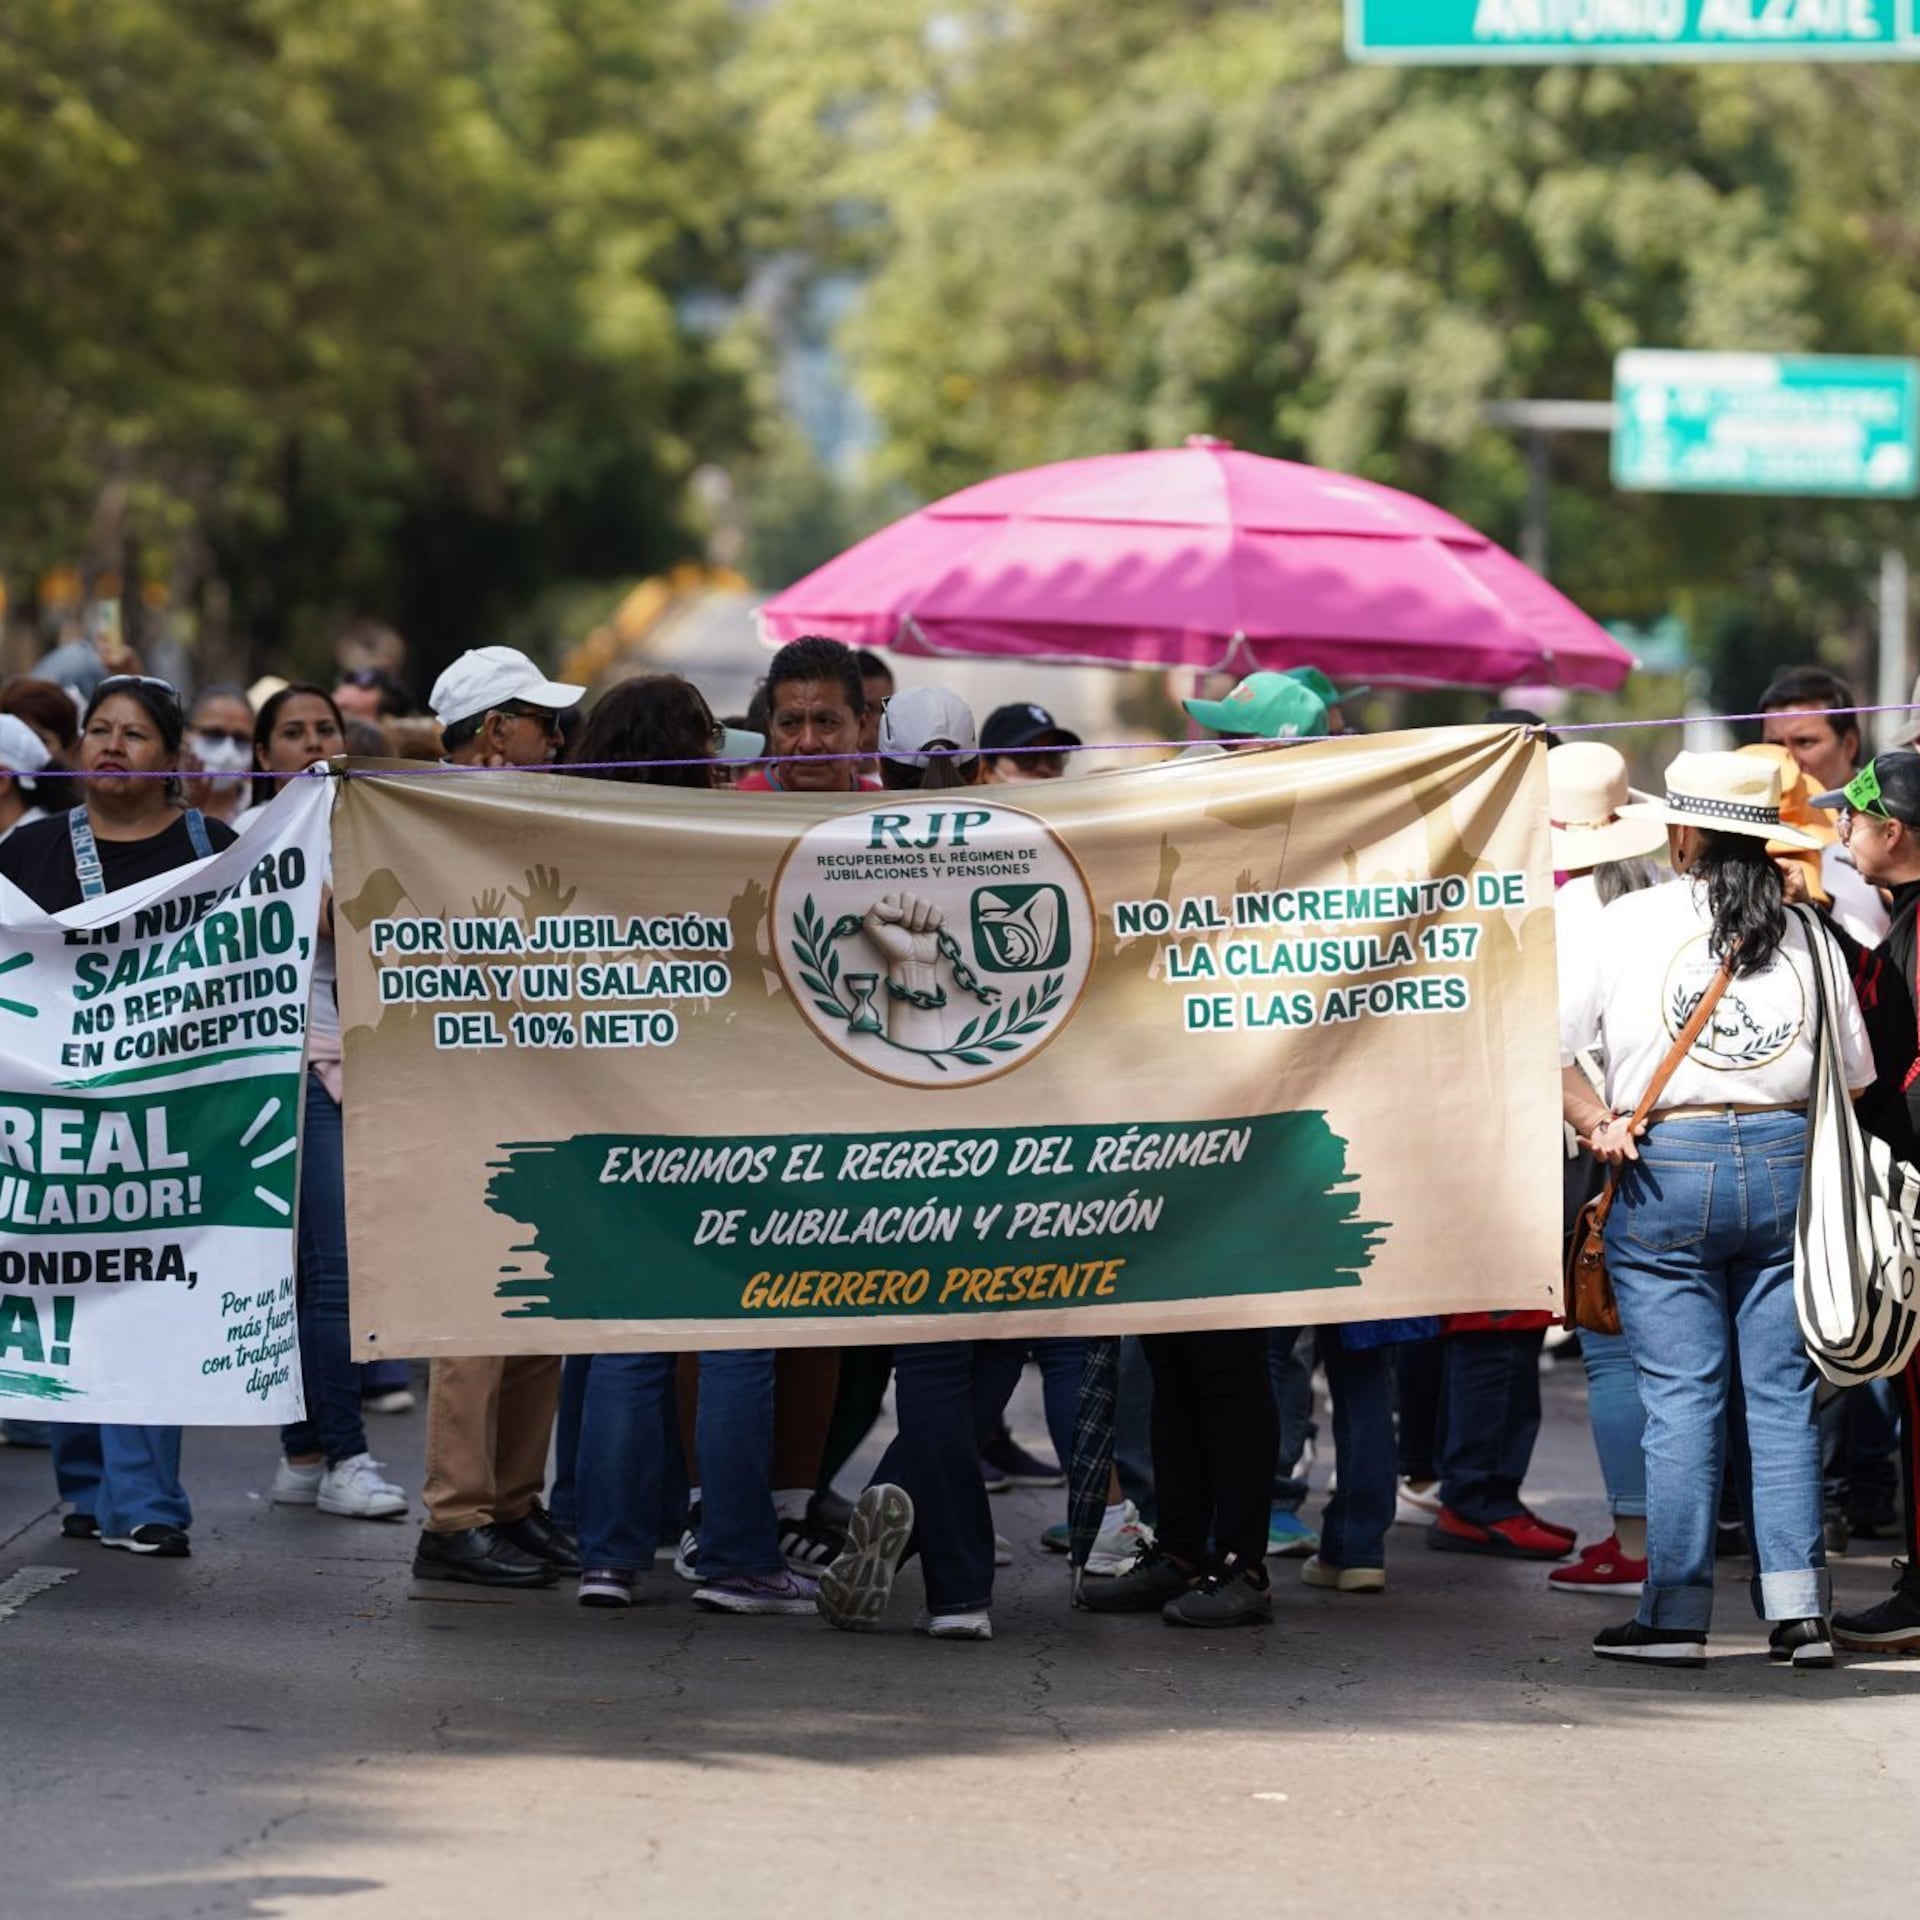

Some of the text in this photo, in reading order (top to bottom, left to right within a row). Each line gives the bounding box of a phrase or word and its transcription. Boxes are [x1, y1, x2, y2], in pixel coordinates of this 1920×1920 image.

[866, 811, 992, 850] RJP
[817, 848, 1038, 867] RECUPEREMOS EL RÉGIMEN DE
[823, 863, 1031, 881] JUBILACIONES Y PENSIONES
[1118, 874, 1524, 933] NO AL INCREMENTO DE
[72, 899, 310, 1001] SALARIO,
[374, 911, 729, 951] POR UNA JUBILACIÓN
[1169, 927, 1480, 978] LA CLAUSULA 157
[71, 963, 299, 1036] NO REPARTIDO
[382, 964, 727, 1000] DIGNA Y UN SALARIO
[1188, 978, 1466, 1029] DE LAS AFORES
[60, 1003, 306, 1068] EN CONCEPTOS!
[438, 1013, 675, 1044] DEL 10% NETO
[0, 1106, 189, 1175] REAL
[599, 1126, 1251, 1185] EXIGIMOS EL REGRESO DEL RÉGIMEN
[693, 1190, 1164, 1247] DE JUBILACIÓN Y PENSIÓN
[221, 1291, 252, 1317] Por
[256, 1288, 276, 1308] un
[741, 1259, 1126, 1309] GUERRERO PRESENTE
[227, 1315, 262, 1342] más
[202, 1355, 232, 1375] con
[246, 1367, 289, 1401] dignos
